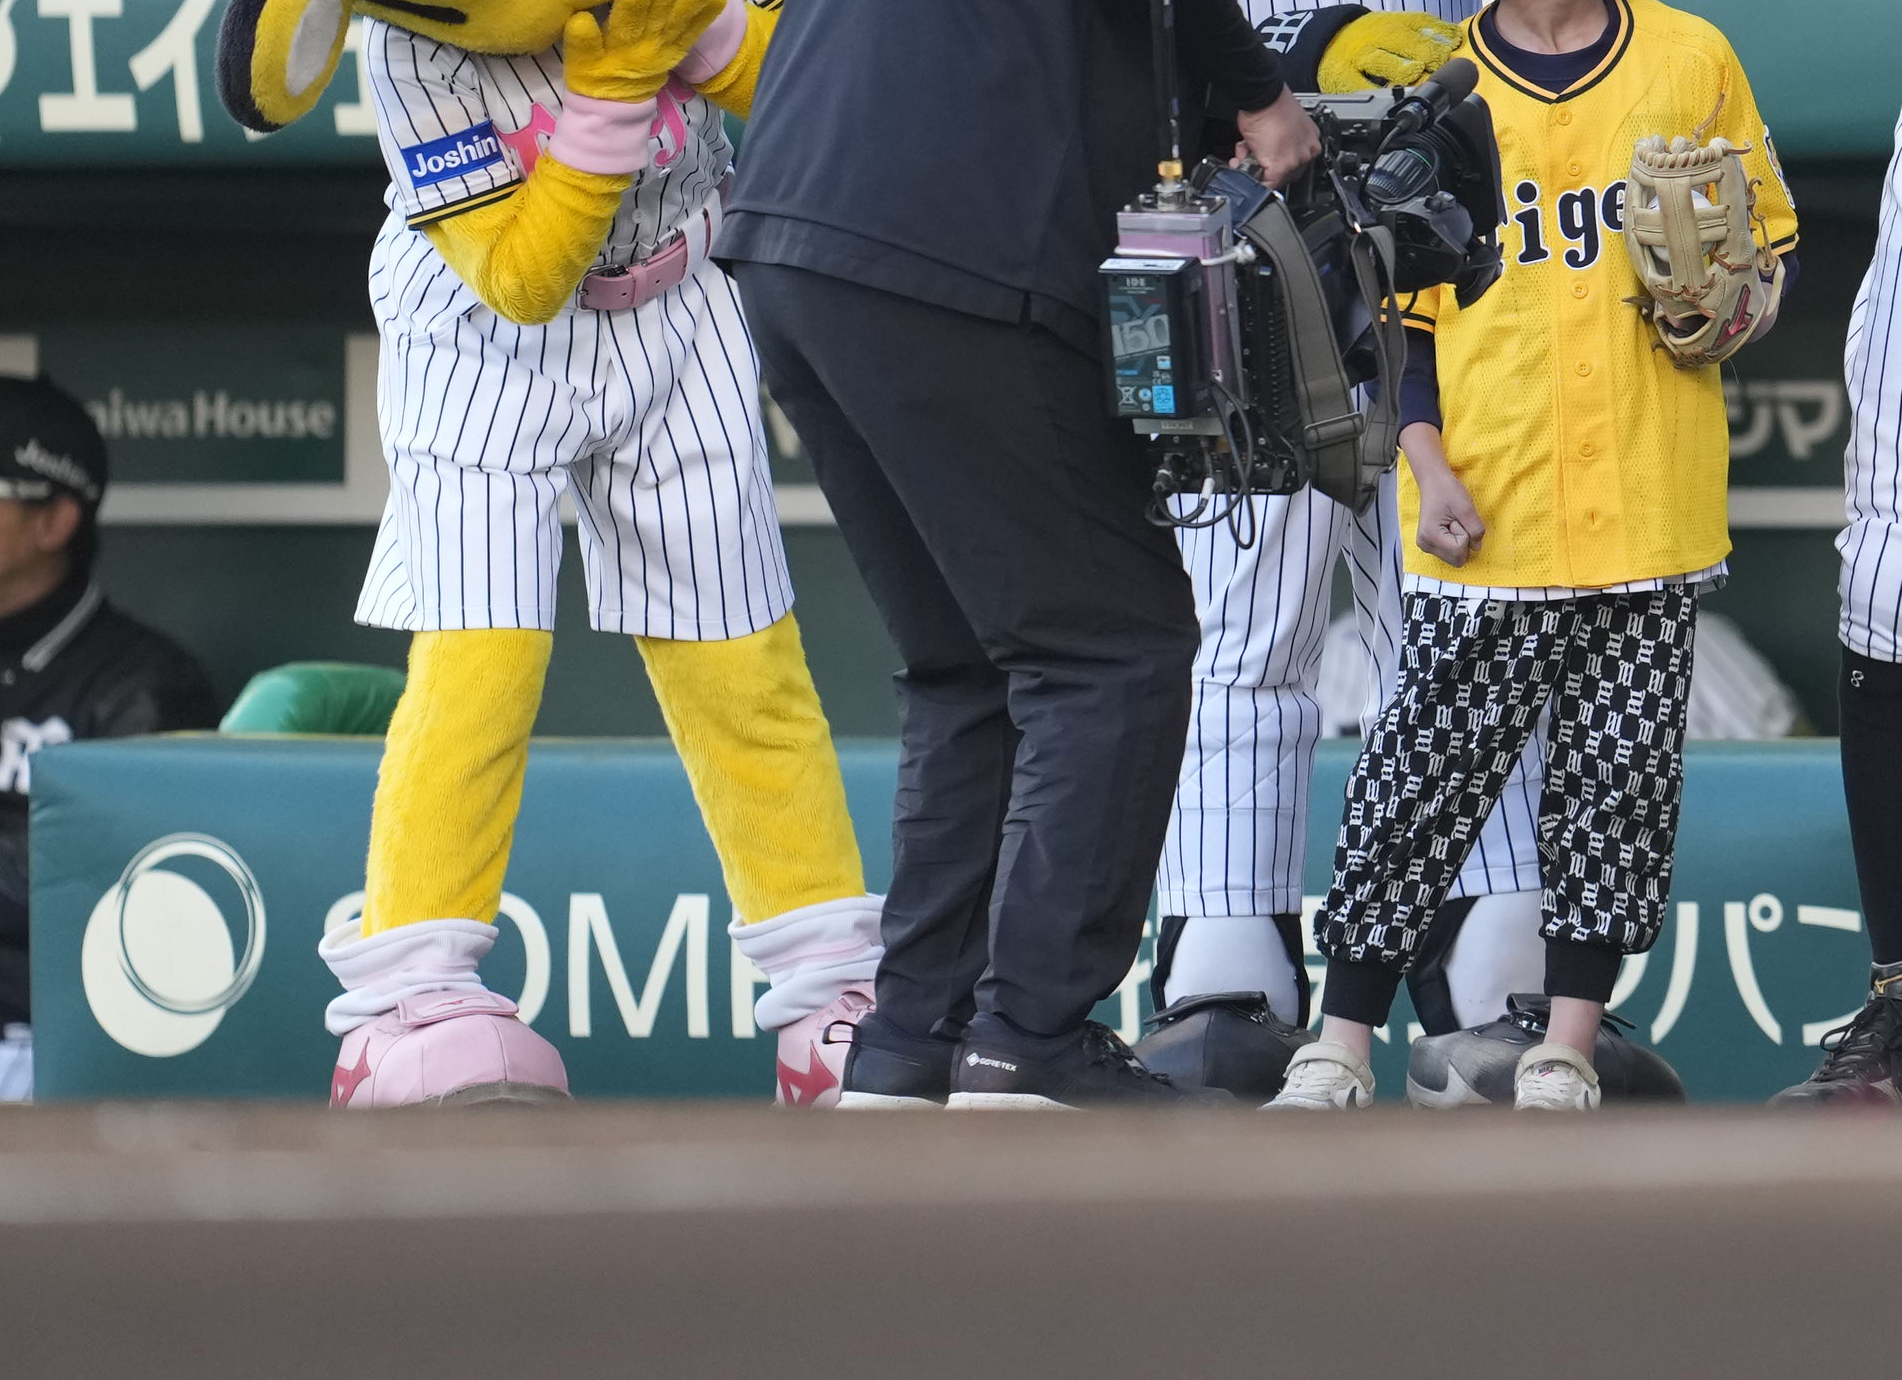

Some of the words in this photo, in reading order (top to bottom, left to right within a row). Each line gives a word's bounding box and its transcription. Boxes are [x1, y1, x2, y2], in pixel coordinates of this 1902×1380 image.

[412, 134, 498, 179] Joshin
[1495, 179, 1628, 271] ige
[193, 389, 336, 437] House
[1724, 382, 1842, 459] ジマ
